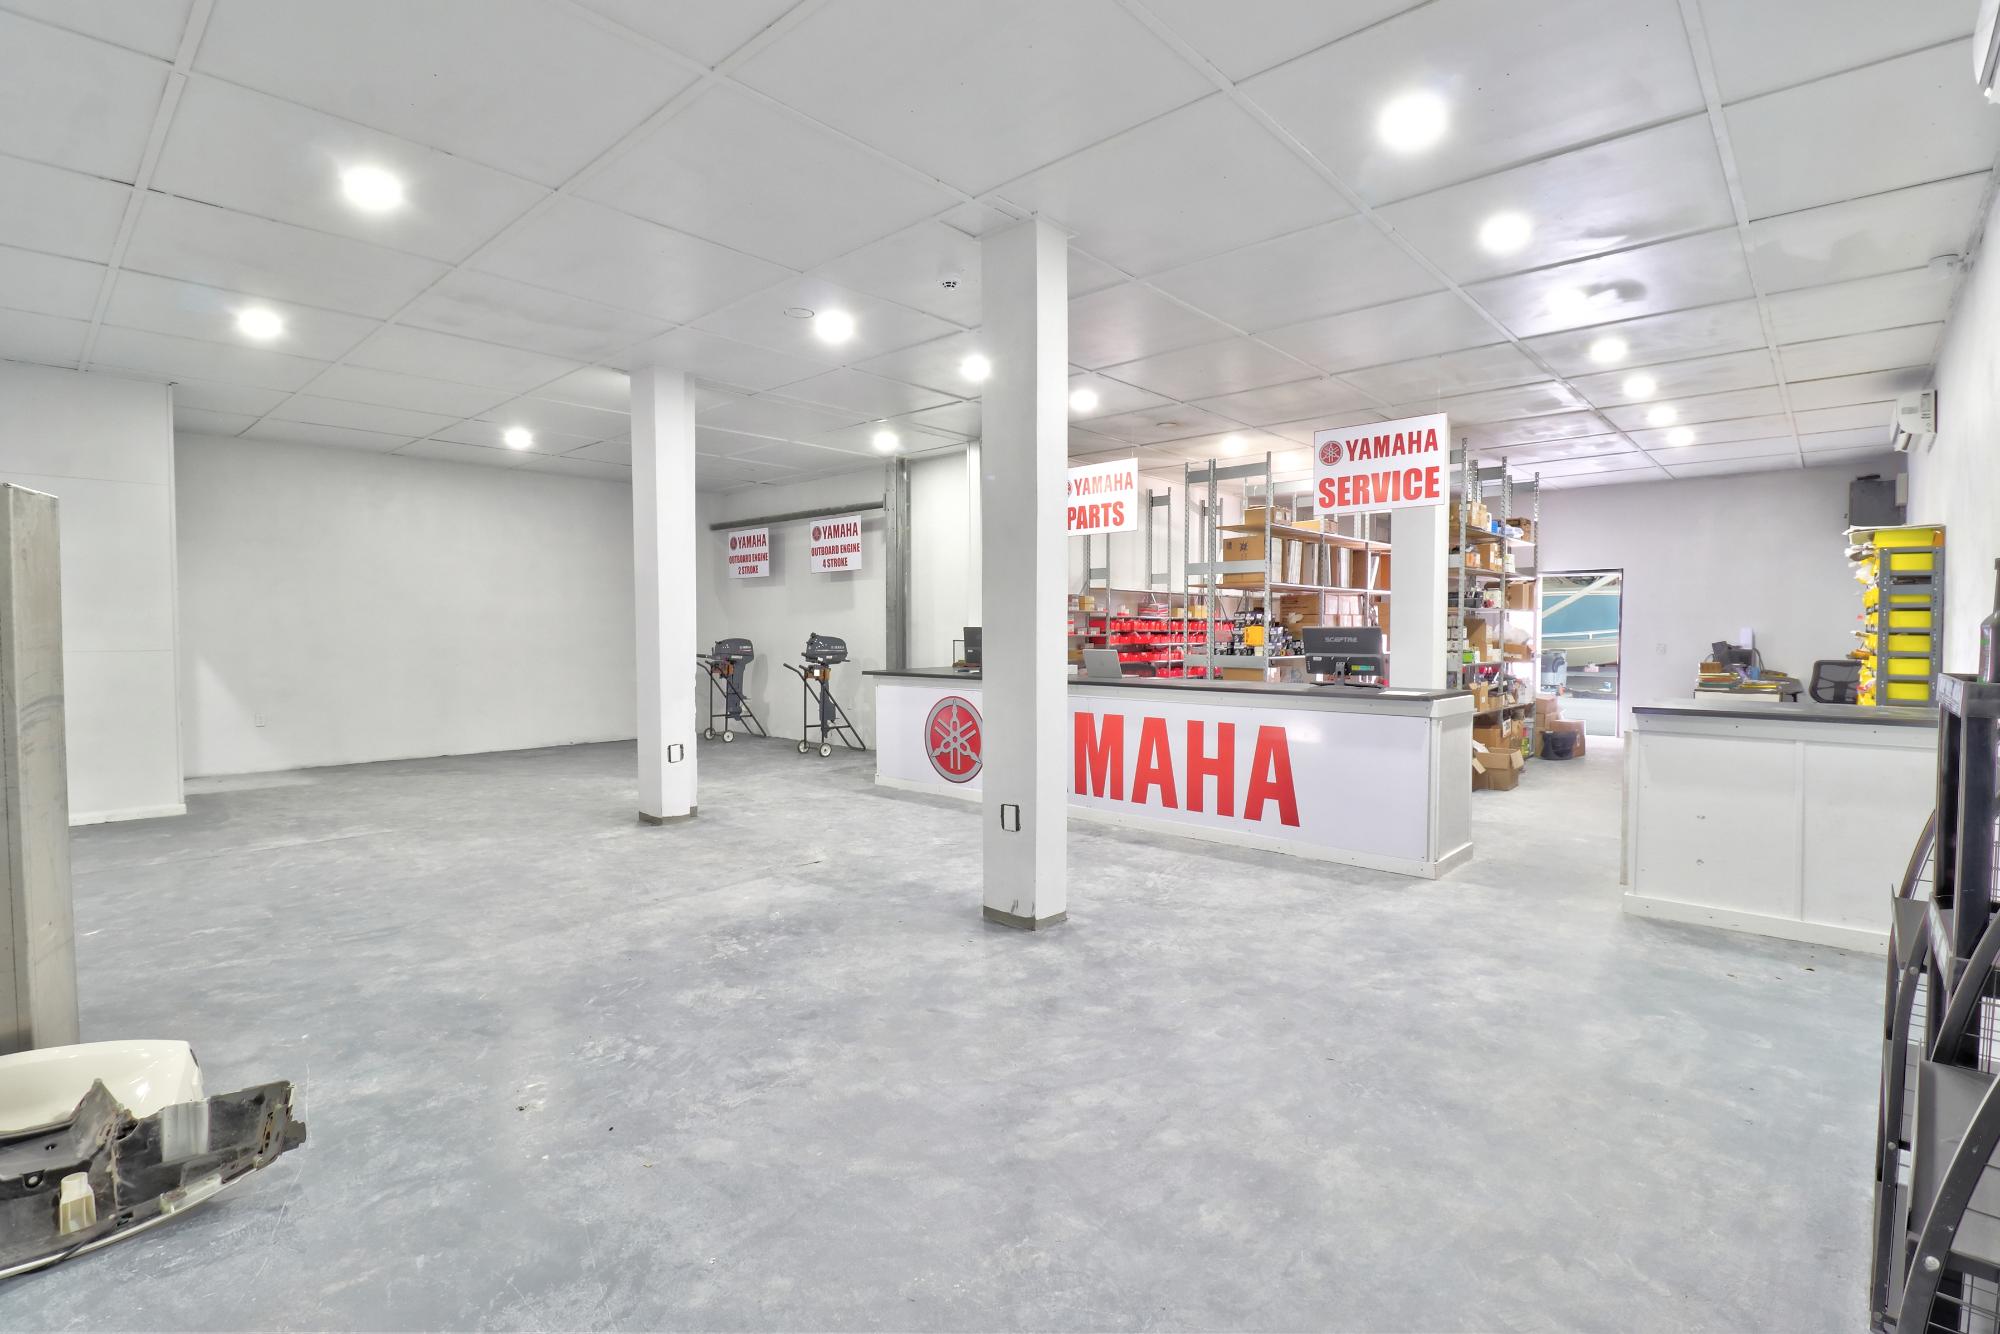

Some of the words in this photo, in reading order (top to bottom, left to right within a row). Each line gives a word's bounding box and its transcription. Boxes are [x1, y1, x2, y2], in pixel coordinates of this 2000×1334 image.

[1345, 428, 1438, 462] YAMAHA
[1074, 471, 1133, 496] YAMAHA
[1318, 466, 1440, 508] SERVICE
[1067, 500, 1125, 530] PARTS
[822, 522, 858, 539] YAMAHA
[738, 534, 767, 549] YAMAHA
[811, 545, 839, 556] OUTBOARD
[840, 543, 860, 553] ENGINE
[729, 554, 751, 564] OUTBOARD
[752, 552, 768, 562] ENGINE
[822, 559, 826, 568] 4
[827, 557, 848, 568] STROKE
[738, 567, 741, 575] 2
[742, 565, 759, 574] STROKE
[1074, 711, 1300, 828] MAHA
